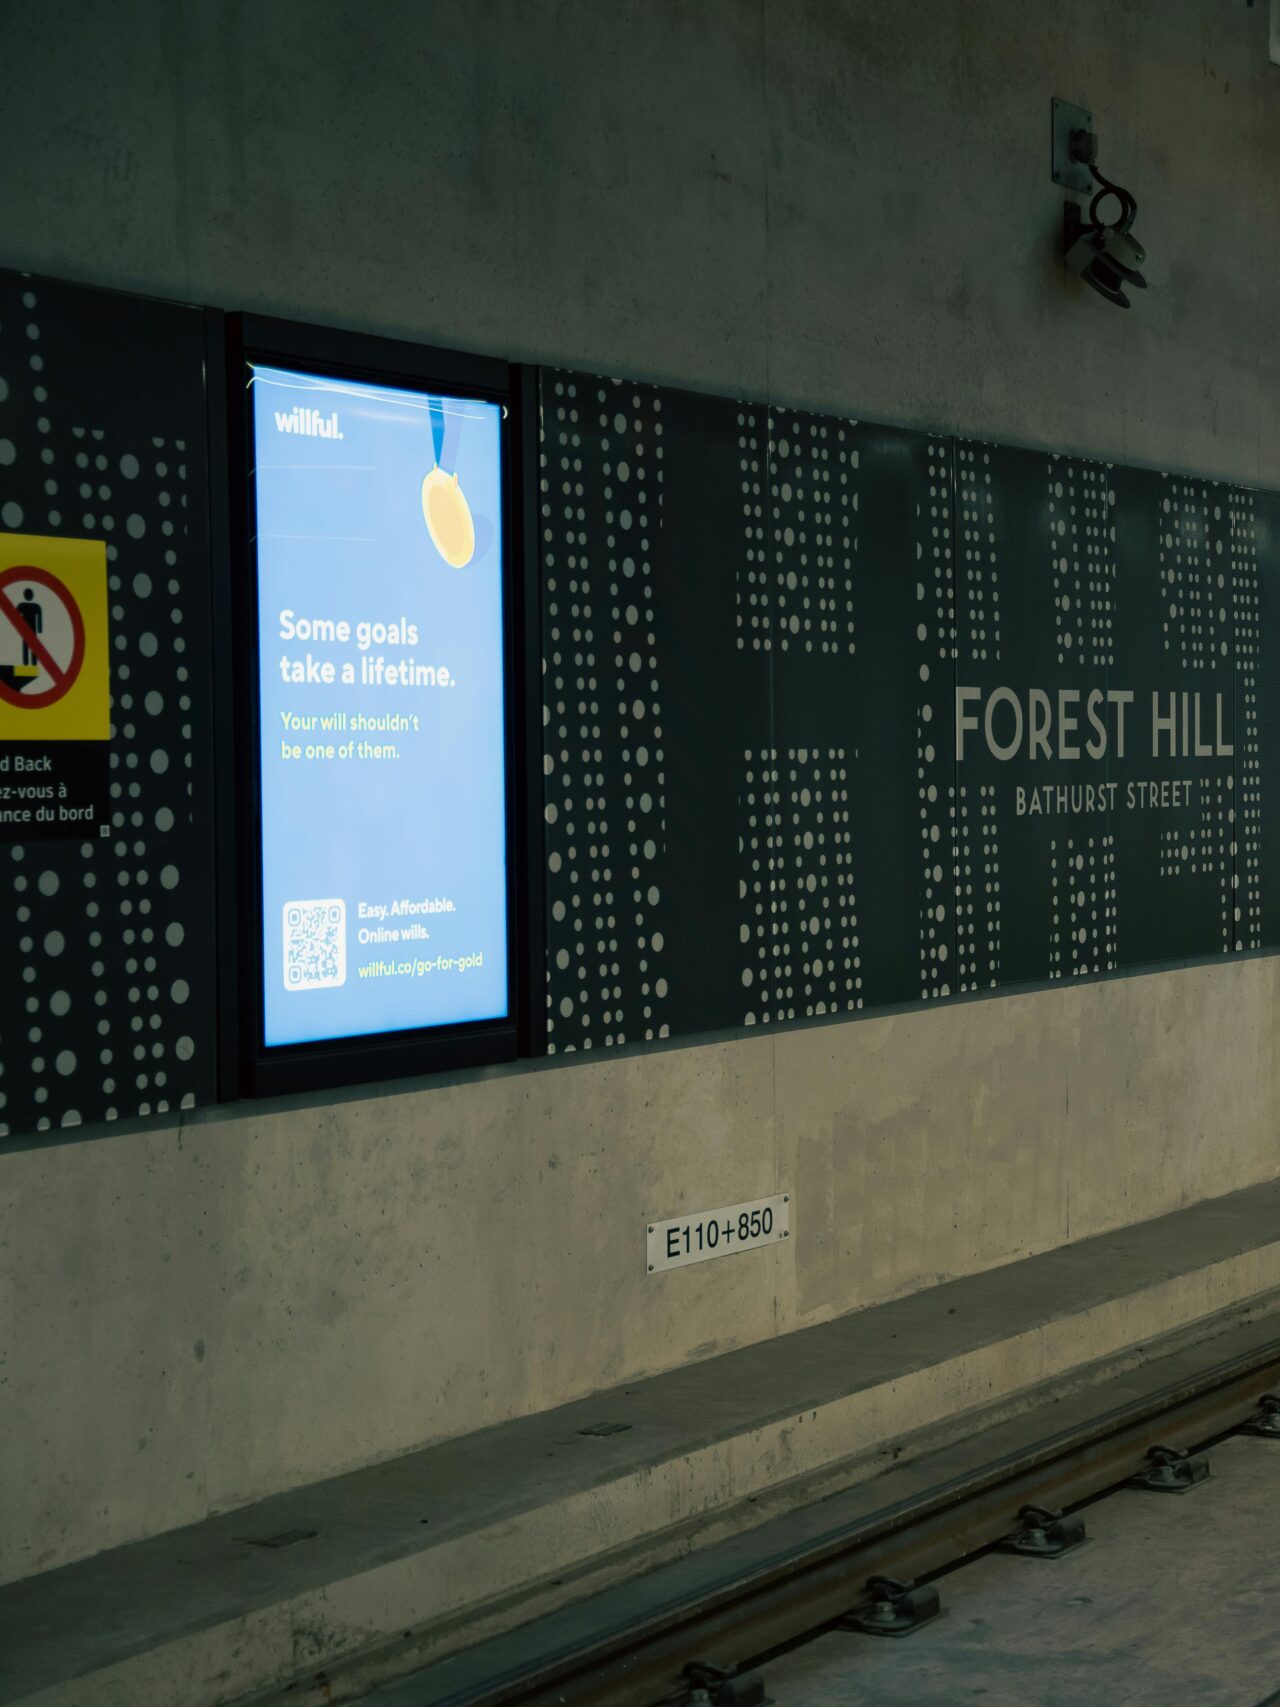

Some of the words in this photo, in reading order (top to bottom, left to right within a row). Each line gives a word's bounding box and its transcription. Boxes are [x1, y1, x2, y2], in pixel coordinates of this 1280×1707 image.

[274, 406, 344, 440] willful.
[279, 609, 351, 642] Some
[356, 616, 419, 651] goals
[279, 653, 336, 684] take
[341, 662, 355, 684] a
[361, 655, 456, 687] lifetime.
[280, 711, 318, 731] Your
[320, 712, 346, 731] will
[350, 712, 420, 732] shouldn't
[956, 686, 1134, 761] FOREST
[1152, 691, 1234, 758] HILL
[281, 740, 302, 760] be
[305, 744, 335, 759] one
[338, 740, 354, 759] of
[357, 740, 400, 760] them.
[14, 755, 52, 772] Back
[58, 782, 67, 798] à
[1016, 782, 1118, 816] BATHURST
[1126, 780, 1193, 810] STREET
[36, 806, 54, 821] du
[59, 804, 93, 821] bord
[358, 901, 389, 920] Easy.
[391, 897, 456, 916] Affordable.
[358, 927, 400, 945] Online
[401, 923, 430, 941] wills.
[358, 952, 484, 978] willful.co/go-for-gold
[667, 1207, 773, 1258] E110+850
